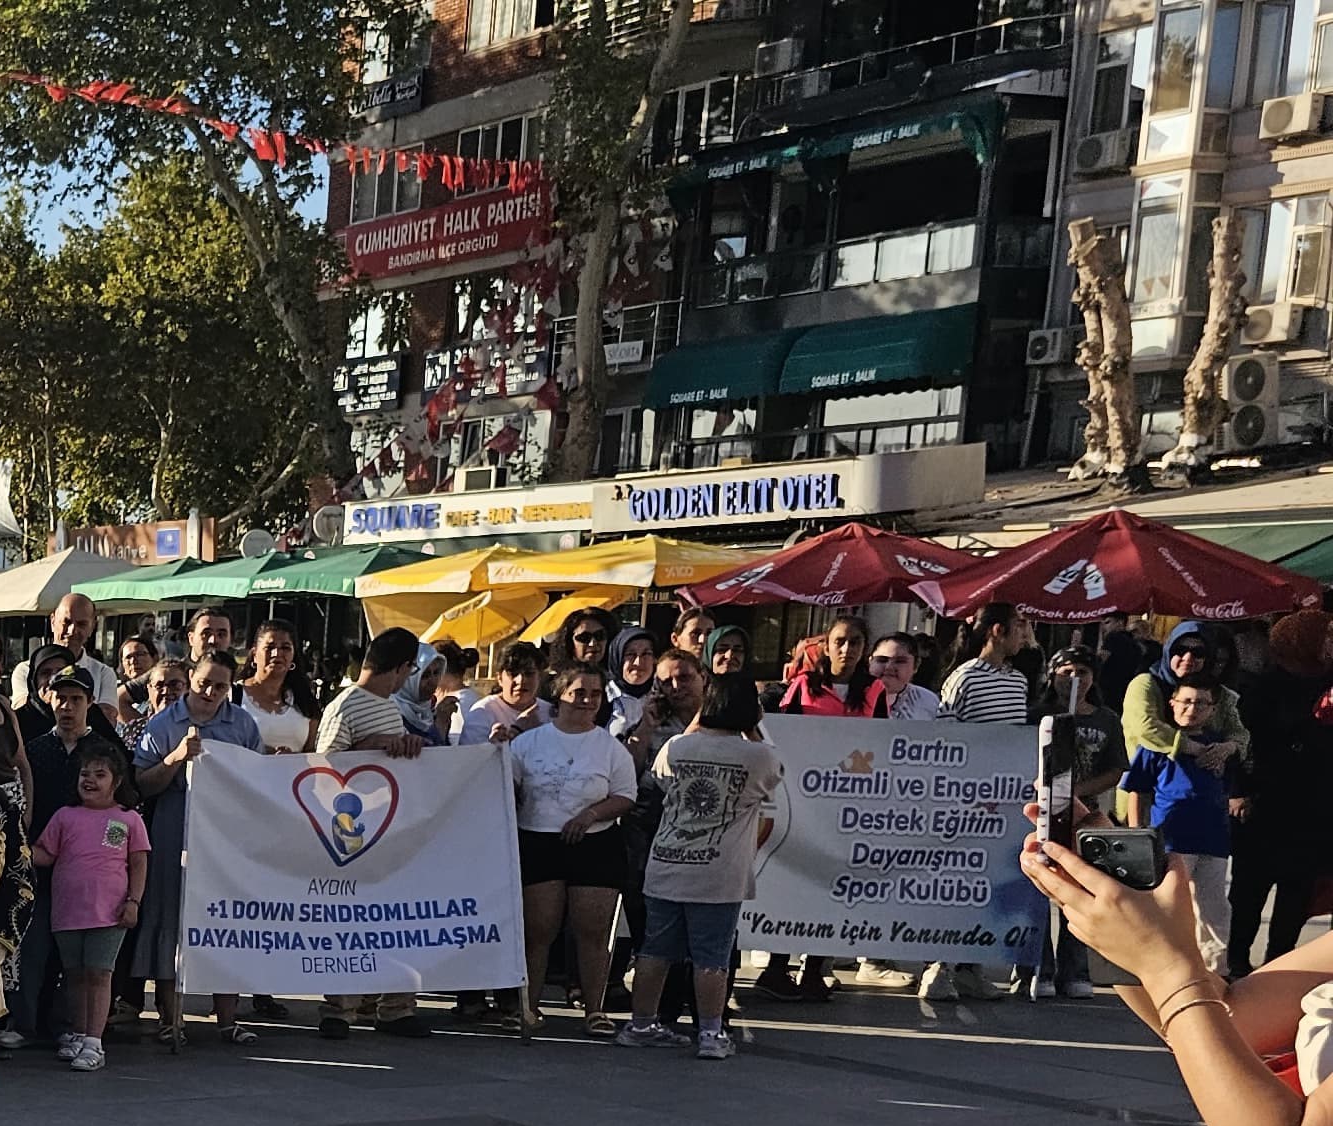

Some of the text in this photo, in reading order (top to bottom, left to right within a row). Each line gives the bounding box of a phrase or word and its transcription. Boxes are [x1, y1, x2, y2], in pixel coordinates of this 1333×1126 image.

[355, 217, 437, 256] CUMHURİYET
[443, 207, 480, 236] HALK
[388, 231, 499, 269] BANDIRMA İLÇE ÖRGÜTÜ
[629, 472, 845, 522] GOLDEN ELIT OTEL
[350, 503, 442, 535] SQUARE
[891, 737, 965, 763] Bartın
[801, 769, 1034, 803] Otizmli ve Engellile
[840, 806, 1005, 839] Destek Eğitim
[851, 842, 984, 871] Dayanışma
[308, 878, 357, 896] AYDIN
[833, 875, 989, 903] Spor Kulübü
[232, 899, 295, 922] DOWN
[298, 897, 478, 923] SENDROMLULAR
[188, 923, 501, 954] DAYANIŞMA ve YARDIMLAŞMA
[839, 919, 883, 947] için
[889, 921, 996, 947] Yanımda
[301, 952, 377, 974] DERNEĞİ
